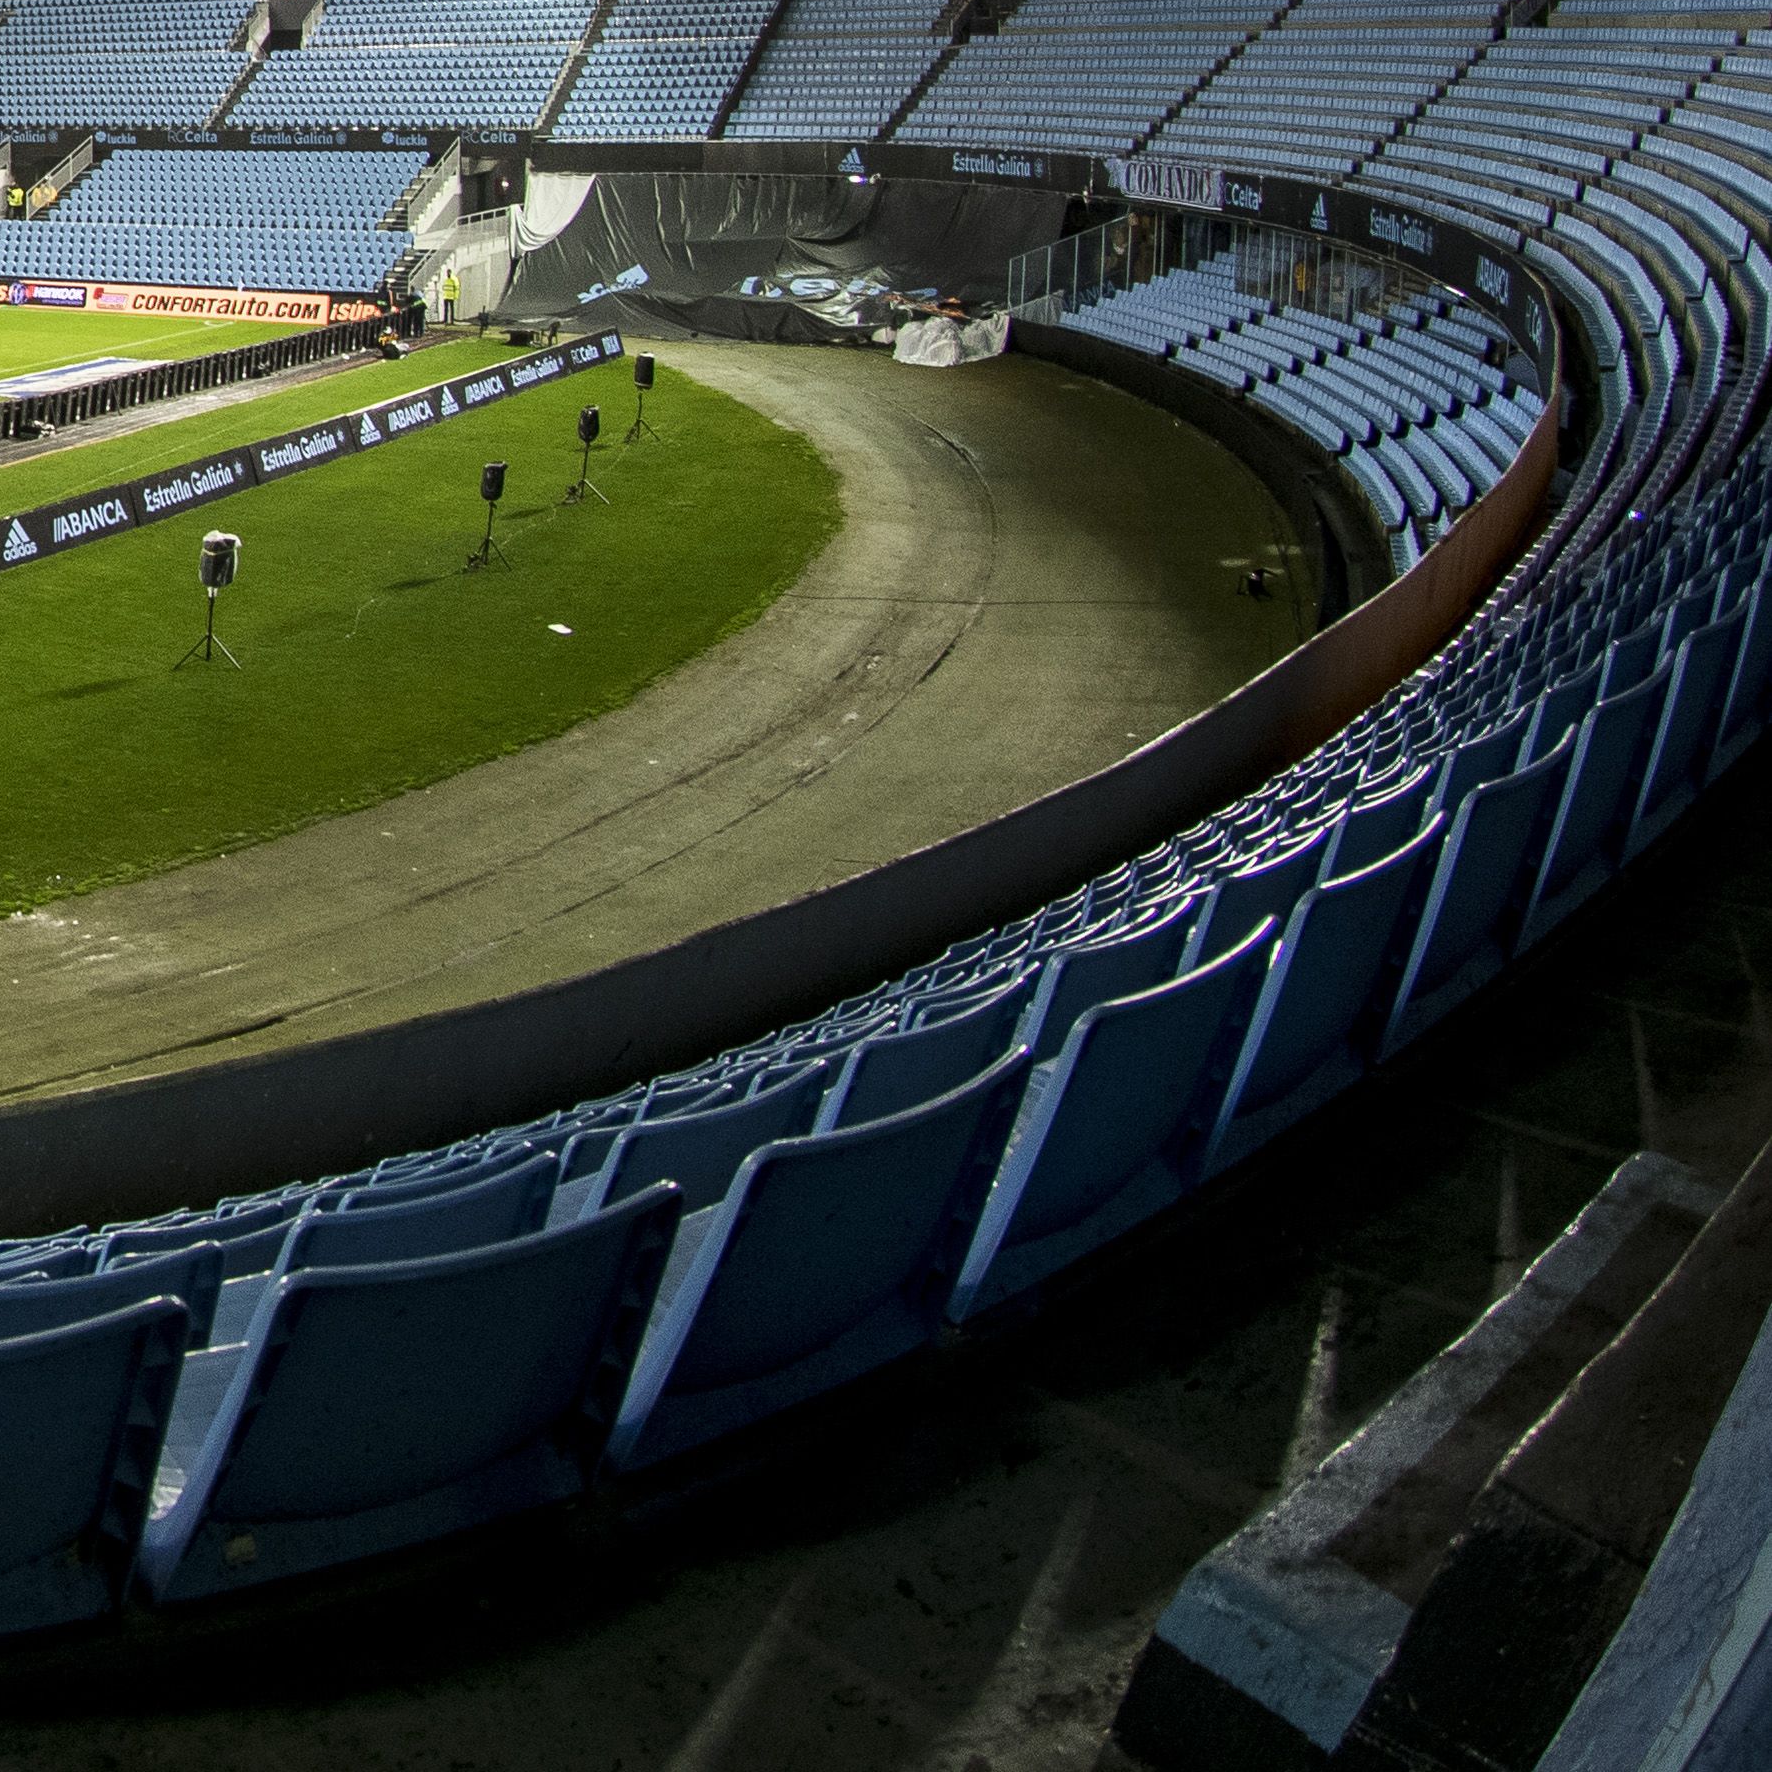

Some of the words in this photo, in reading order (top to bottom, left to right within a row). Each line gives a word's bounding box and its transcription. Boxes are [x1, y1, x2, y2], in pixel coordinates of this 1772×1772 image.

[250, 132, 292, 145] Estrella
[294, 131, 333, 145] Galicia
[395, 134, 427, 146] luckia
[953, 152, 995, 175] Estrella
[996, 154, 1031, 177] Galicia
[260, 443, 302, 472] Estrella
[300, 430, 337, 459] Galicia
[144, 478, 190, 513] Estrella
[189, 462, 234, 495] Galicia
[3, 540, 37, 561] adidas
